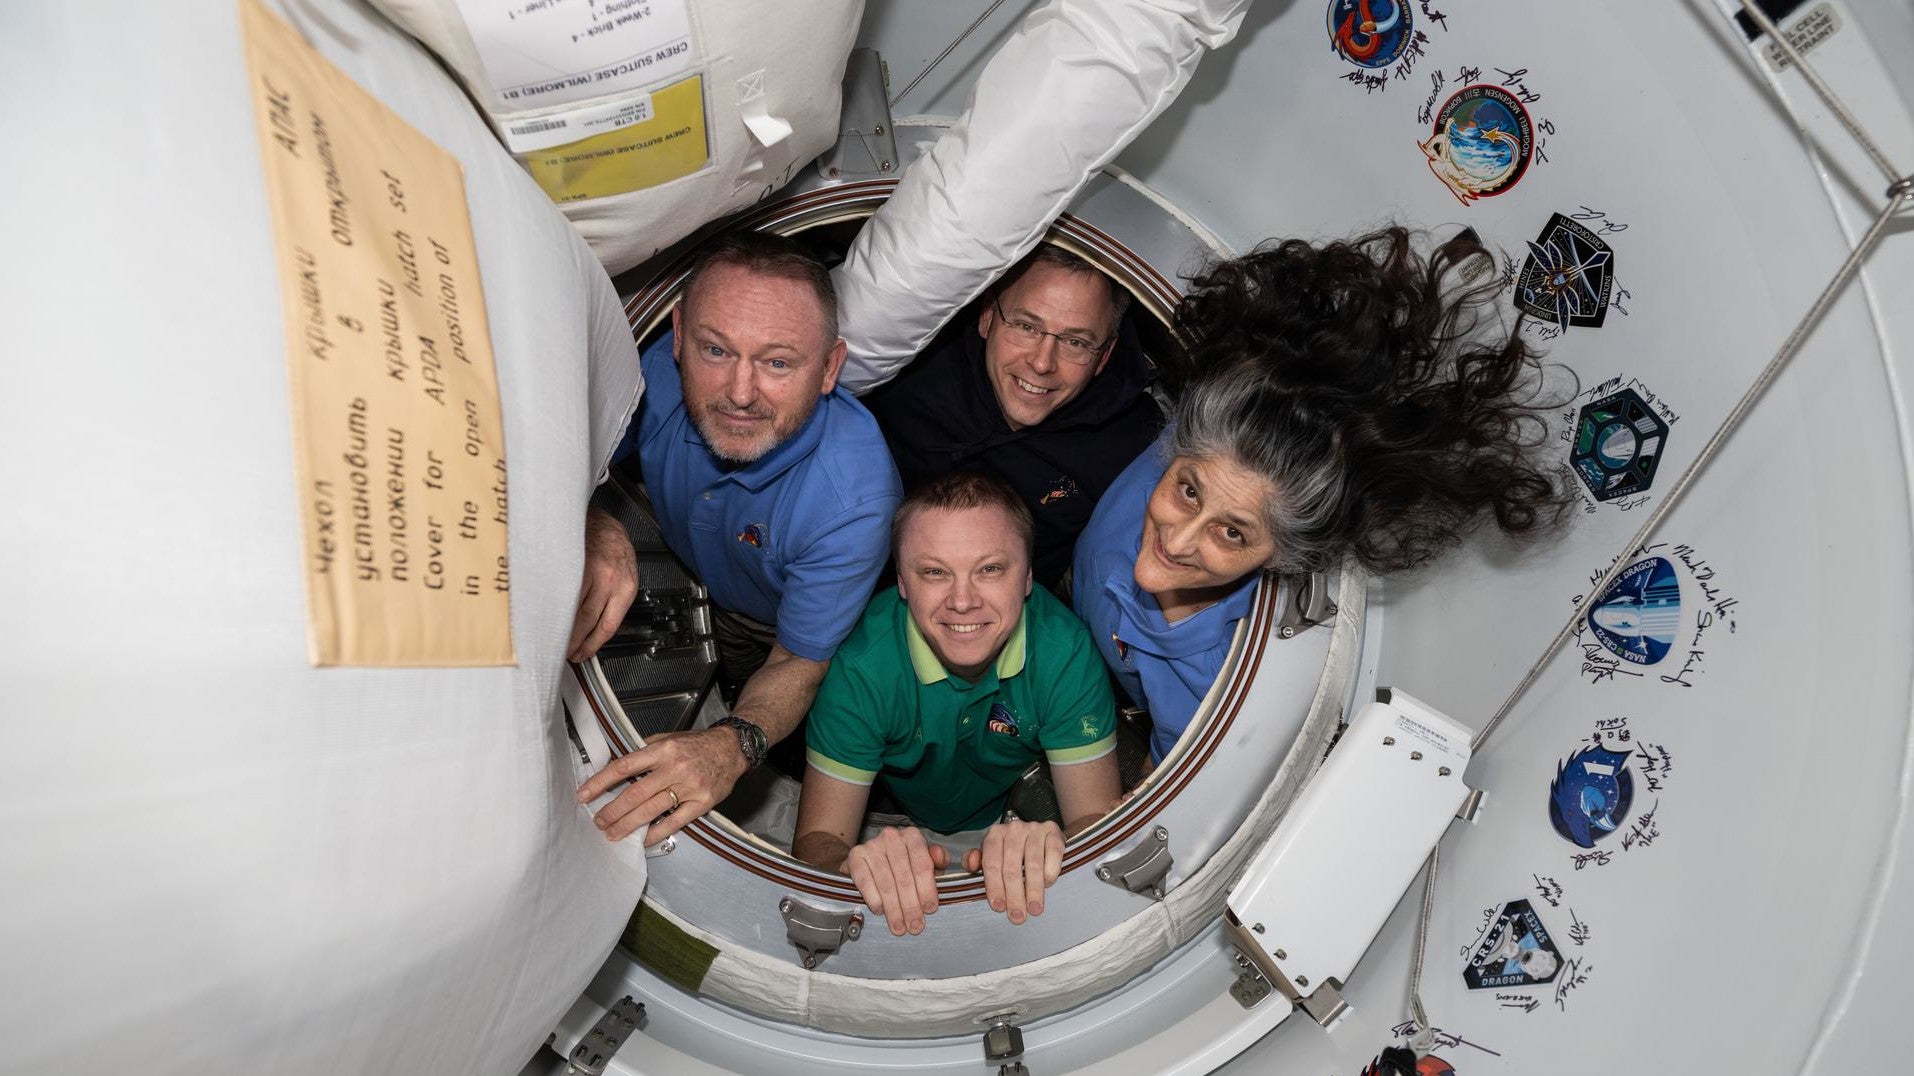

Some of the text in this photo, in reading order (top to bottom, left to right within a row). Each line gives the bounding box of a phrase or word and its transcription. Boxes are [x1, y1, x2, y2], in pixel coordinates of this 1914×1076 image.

[587, 20, 615, 37] Brick
[616, 6, 651, 26] 2-Week
[1796, 10, 1825, 32] CELL
[1806, 14, 1832, 36] LINE
[503, 41, 689, 100] CREW SUITCASE (WILMORE) B1
[1484, 88, 1522, 115] MOGENSEN
[617, 135, 664, 154] SUITCASE
[665, 126, 691, 143] CREW
[1519, 115, 1531, 157] MOGHBELI
[1560, 216, 1605, 250] CRISTOFORETTI
[1518, 268, 1530, 289] HINES
[1599, 274, 1612, 308] WATKINS
[262, 74, 337, 576] Чехол крышки АПАС
[380, 169, 446, 591] Cover for APDA hatch set
[377, 278, 410, 582] положении крышки
[427, 236, 486, 596] in the open position of
[342, 396, 382, 582] установить
[493, 556, 510, 595] the
[1599, 577, 1624, 602] SPACEX
[1623, 558, 1658, 579] DRAGON
[1625, 650, 1647, 663] NASA
[1524, 910, 1549, 943] SPACEX
[1481, 975, 1524, 986] DRAGON
